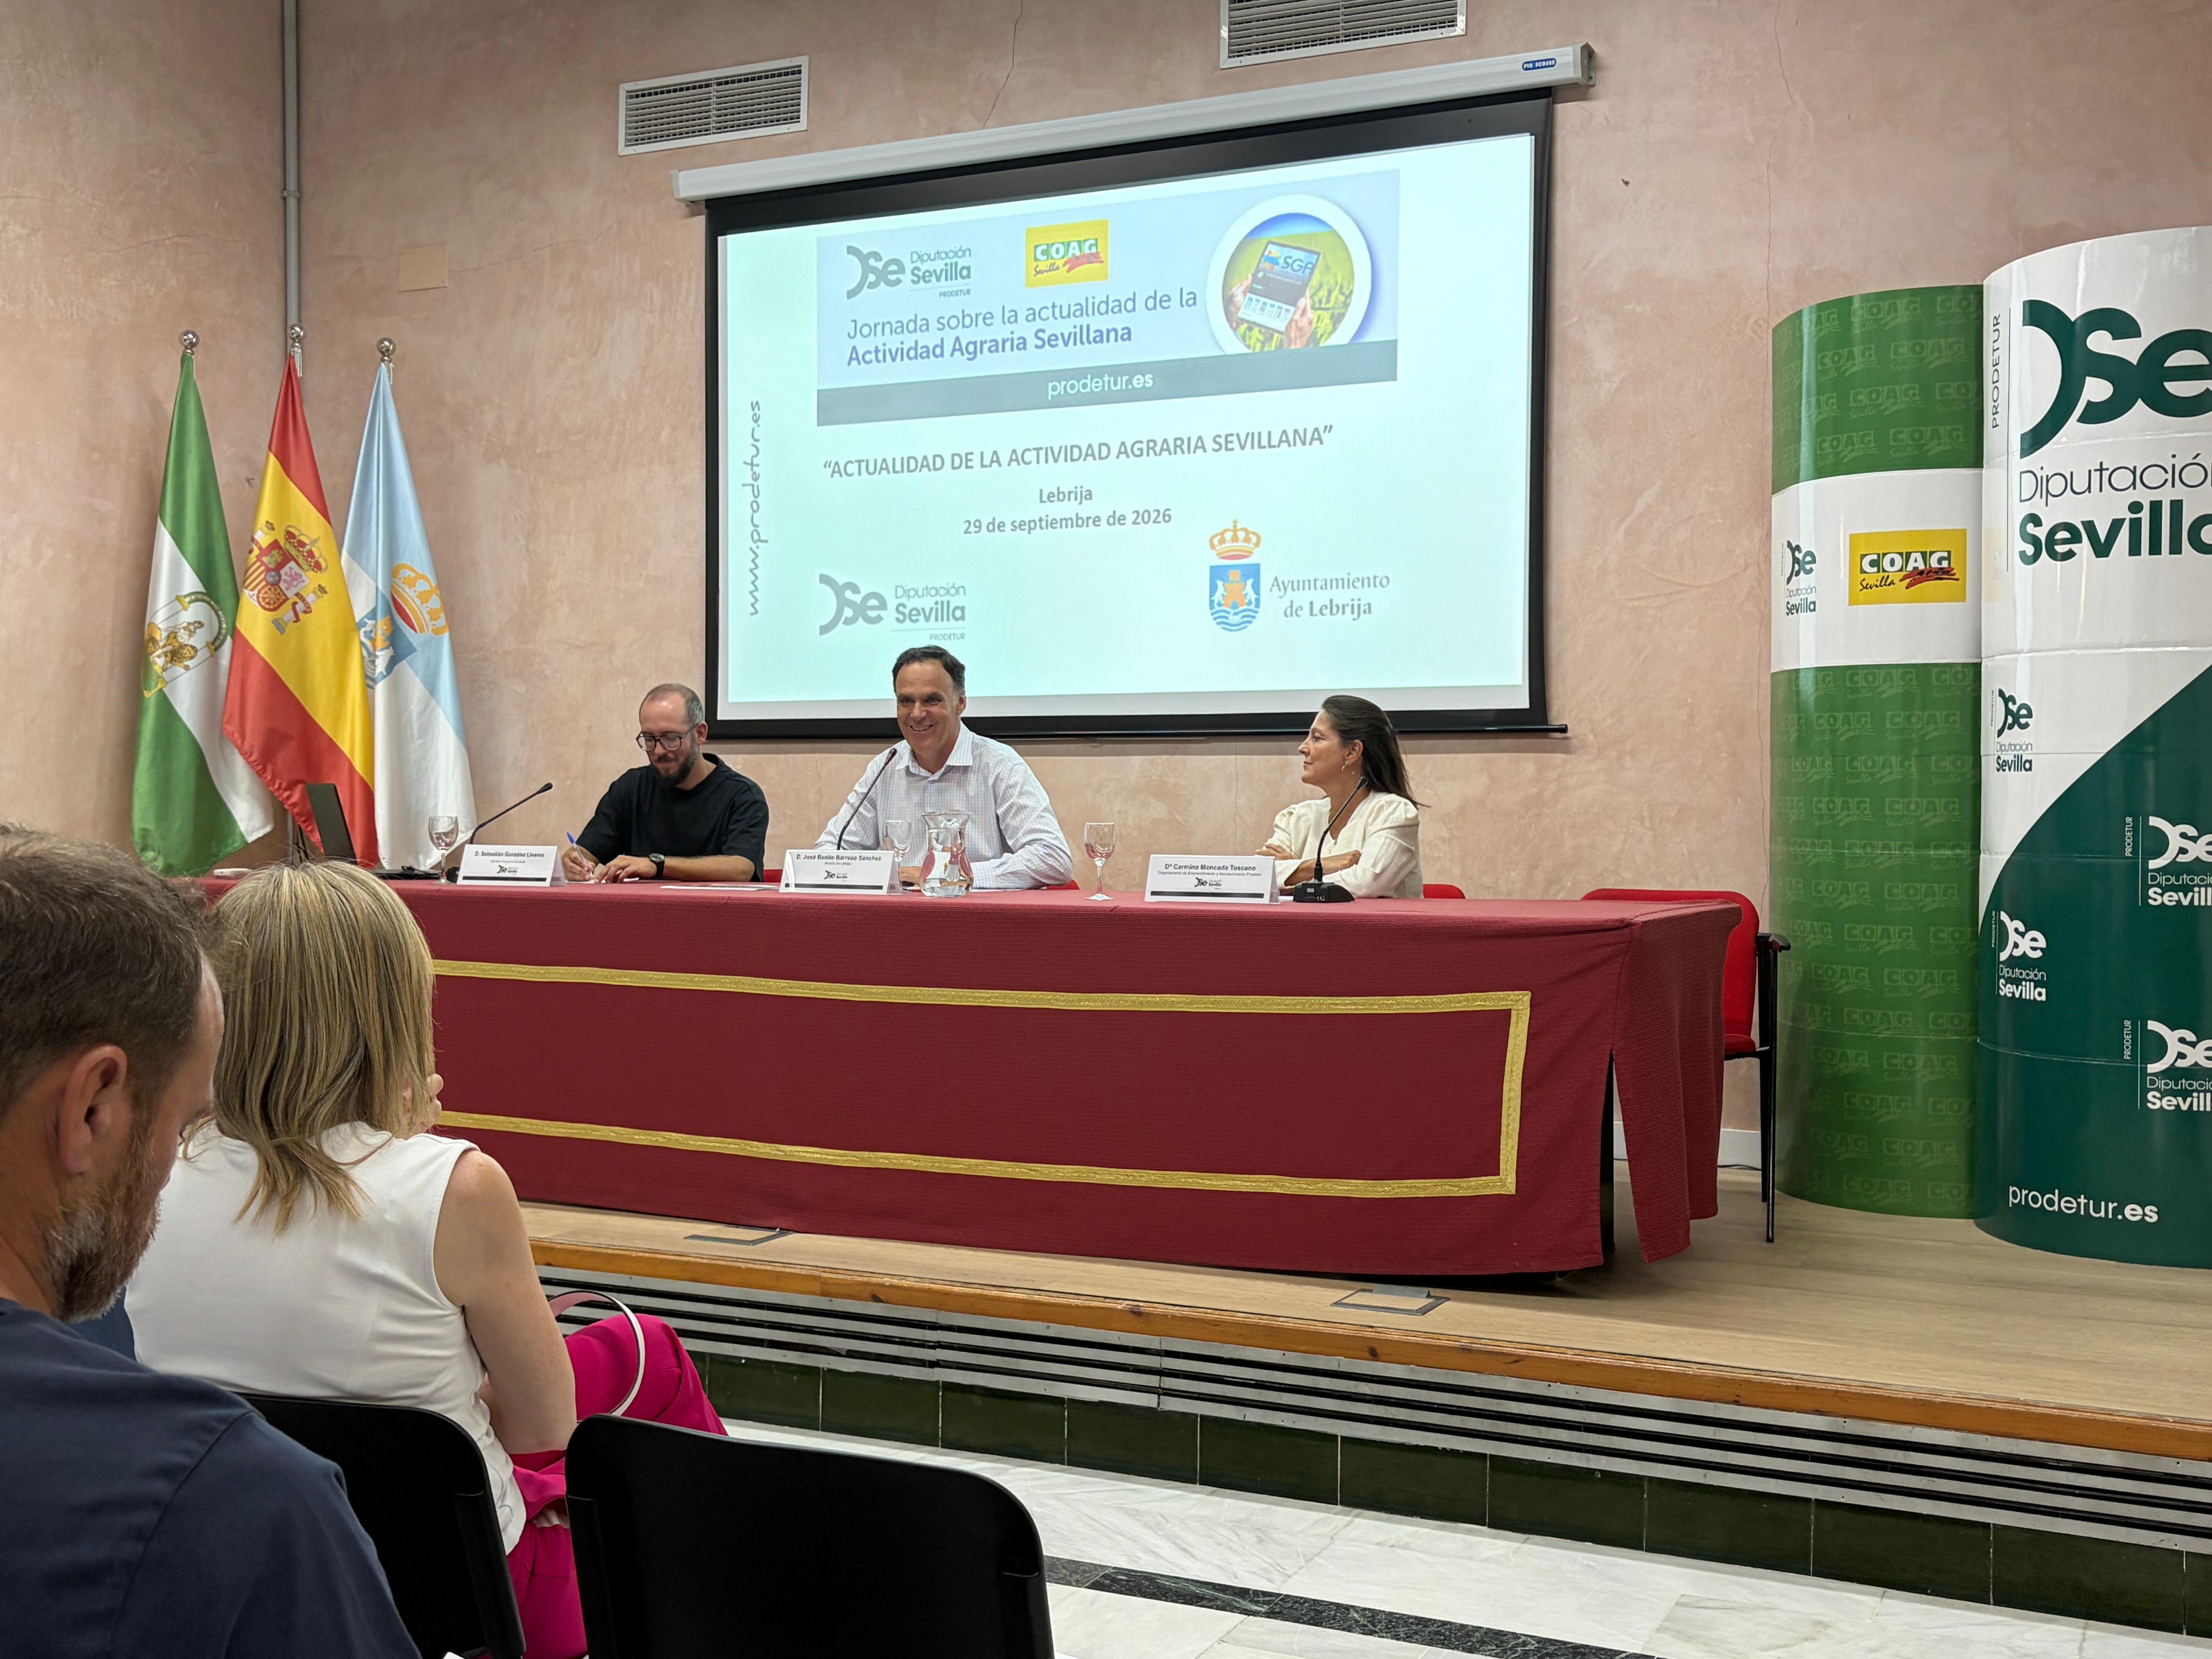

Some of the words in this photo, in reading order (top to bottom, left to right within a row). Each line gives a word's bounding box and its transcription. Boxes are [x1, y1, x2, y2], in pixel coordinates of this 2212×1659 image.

[910, 246, 972, 264] Diputación
[1036, 239, 1098, 261] COAG
[910, 263, 971, 285] Sevilla
[1033, 264, 1060, 277] Sevilla
[939, 288, 971, 298] PRODETUR
[847, 314, 930, 340] Jornada
[936, 308, 995, 331] sobre
[1001, 305, 1018, 325] la
[1026, 292, 1137, 323] actualidad
[1144, 291, 1172, 310] de
[1180, 287, 1197, 307] la
[1851, 298, 1920, 322] COAG
[847, 336, 945, 366] Actividad
[950, 333, 1028, 361] Agraria
[1034, 324, 1132, 350] Sevillana
[1891, 338, 1964, 359] COAG
[1818, 345, 1875, 370] COAG
[1992, 313, 2001, 429] PRODETUR
[1048, 372, 1153, 399] prodetur.es
[1850, 384, 1919, 407] COAG
[1817, 431, 1874, 454] COAG
[1889, 426, 1963, 445] COAG
[823, 454, 945, 478] “ACTUALIDAD
[950, 451, 974, 470] DE
[980, 450, 1002, 468] LA
[1007, 442, 1112, 467] ACTIVIDAD
[1116, 435, 1208, 459] AGRARIA
[1211, 425, 1333, 452] SEVILLANA”
[2020, 453, 2212, 507] Diputació
[1039, 485, 1093, 505] Lebrija
[742, 400, 769, 616] www.prodetur.es
[963, 519, 982, 535] 29
[986, 517, 1006, 533] de
[1010, 512, 1102, 534] septiembre
[1106, 511, 1126, 527] de
[1131, 508, 1172, 526] 2026
[1859, 550, 1951, 574] COAG
[895, 582, 966, 601] Diputación
[1269, 572, 1390, 599] Ayuntamiento
[1786, 585, 1817, 600] Diputación
[1859, 576, 1896, 592] Sevilla
[895, 600, 966, 624] Sevilla
[1284, 602, 1303, 618] de
[1309, 598, 1373, 621] Lebrija
[1786, 597, 1816, 616] Sevilla
[929, 632, 966, 641] PRODETUR
[1847, 668, 1916, 687] COAG
[1814, 712, 1871, 730] COAG
[1886, 711, 1960, 728] COAG
[1996, 741, 2033, 754] Diputación
[1845, 756, 1915, 772] COAG
[1996, 754, 2032, 772] Sevilla
[1813, 797, 1869, 814] COAG
[1885, 798, 1959, 815] COAG
[1812, 880, 1869, 897] COAG
[2148, 872, 2212, 887] Diputaci
[1885, 883, 1958, 900] COAG
[2148, 887, 2212, 906] Sevill
[1790, 919, 1831, 937] COAG
[1844, 924, 1913, 941] COAG
[1812, 963, 1869, 982] COAG
[1884, 968, 1957, 986] COAG
[1999, 964, 2047, 981] Diputación
[1999, 979, 2046, 1001] Sevilla
[1844, 1008, 1912, 1026] COAG
[1812, 1046, 1868, 1065] COAG
[1843, 1091, 1911, 1111] COAG
[2147, 1091, 2211, 1112] Sevill
[1883, 1138, 1956, 1157] COAG
[2009, 1185, 2158, 1224] prodetur.es
